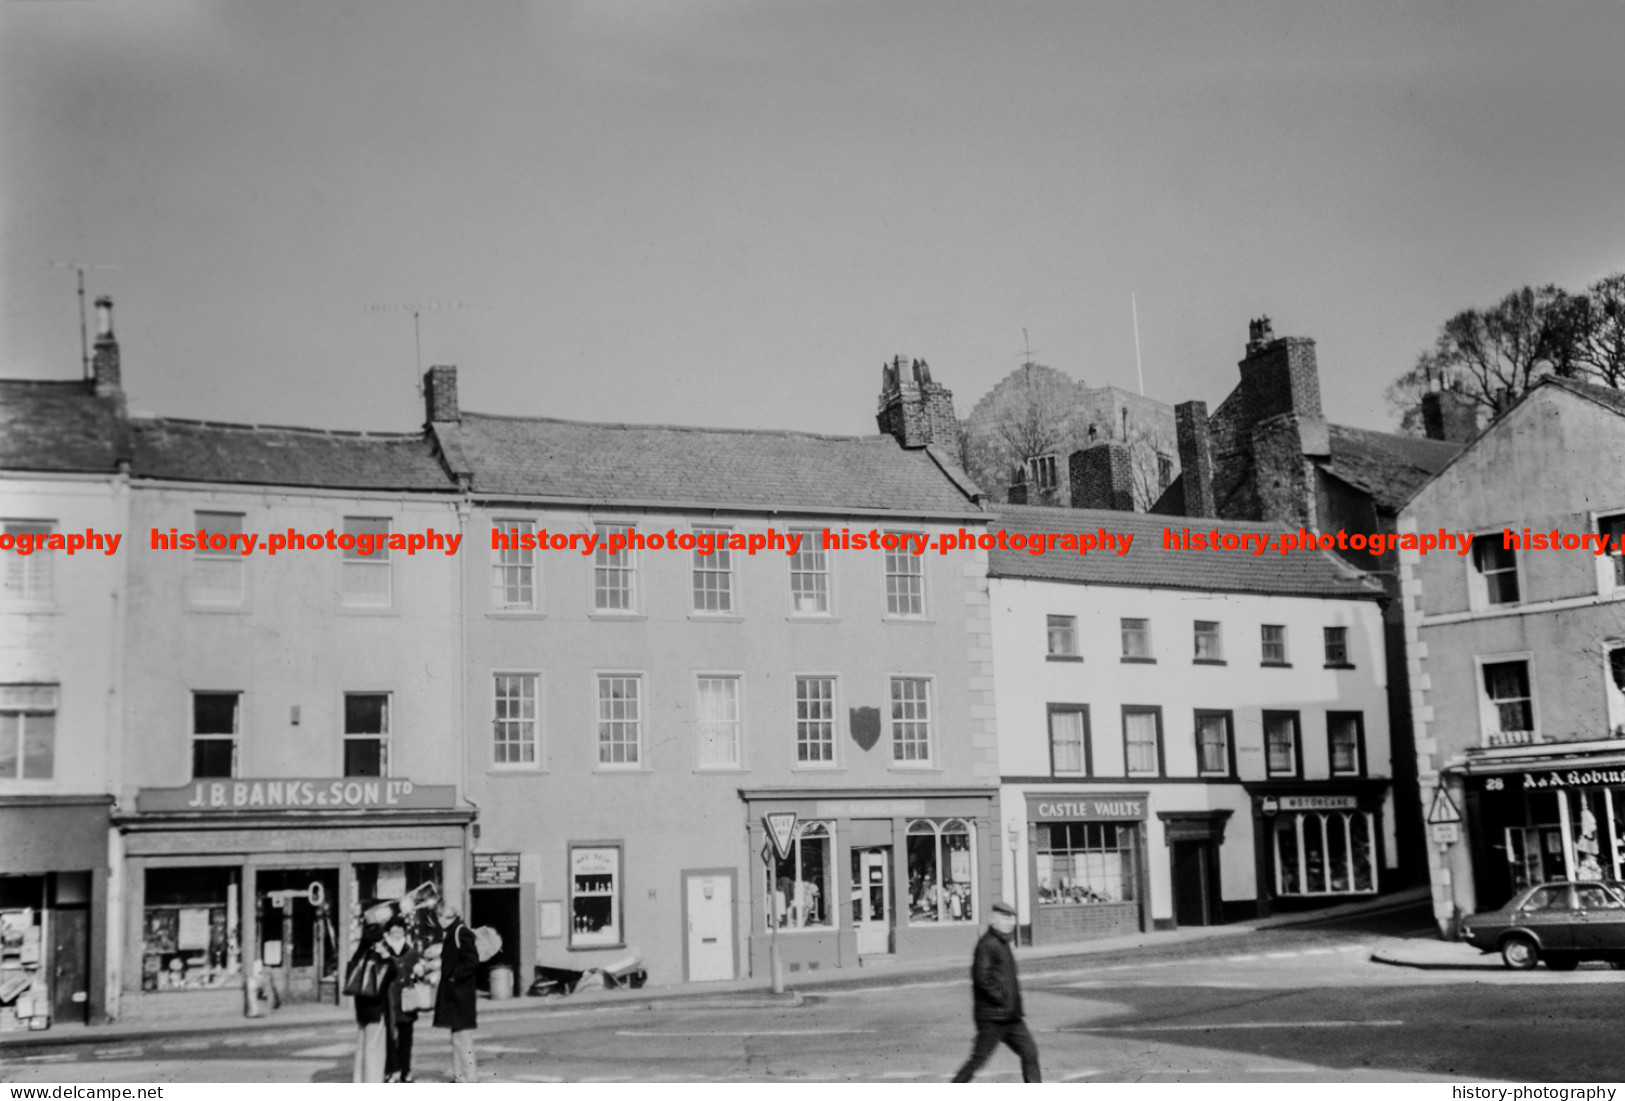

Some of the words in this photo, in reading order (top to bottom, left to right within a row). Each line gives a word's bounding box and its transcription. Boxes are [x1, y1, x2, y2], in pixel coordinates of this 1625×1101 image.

[1485, 778, 1504, 791] 28
[232, 782, 315, 806] BANKS
[329, 781, 379, 805] SON
[1039, 802, 1087, 817] CASTLE
[1094, 801, 1141, 816] VAULTS
[1289, 797, 1348, 808] MOTORCARE
[773, 818, 791, 828] GIVE
